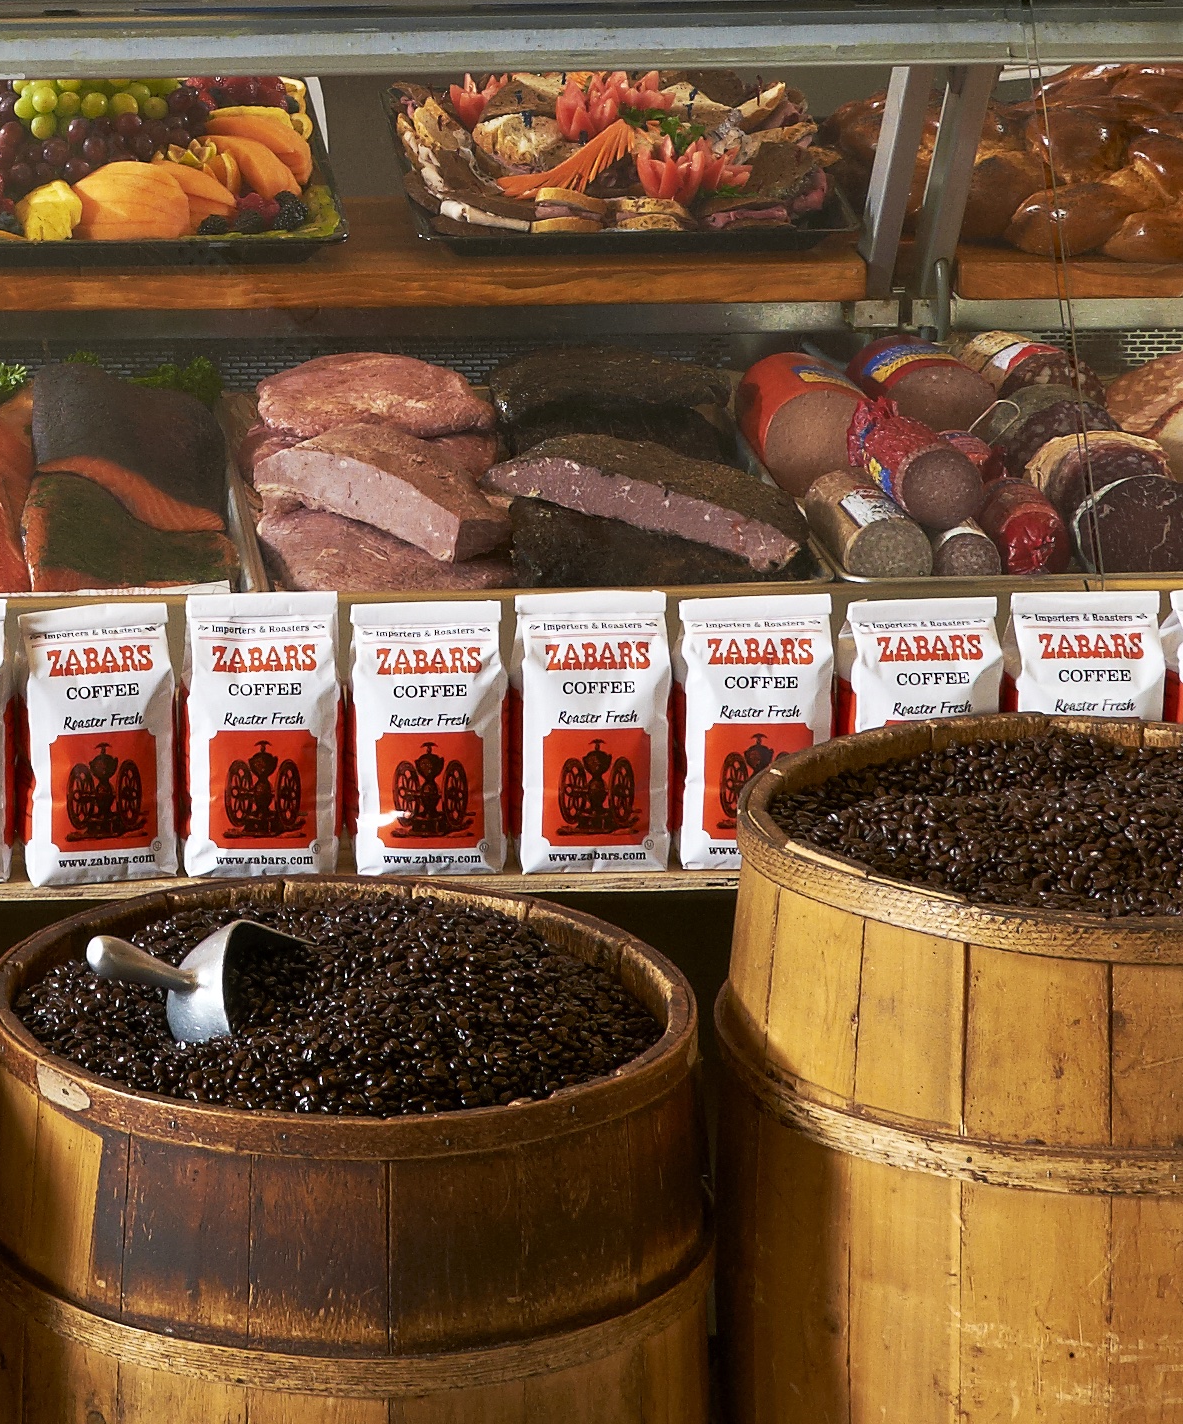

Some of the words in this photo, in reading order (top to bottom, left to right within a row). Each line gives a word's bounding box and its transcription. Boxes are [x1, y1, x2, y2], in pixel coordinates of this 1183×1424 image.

[897, 672, 969, 686] COFFEE
[1059, 670, 1131, 682] COFFEE
[229, 683, 301, 696] COFFEE
[562, 681, 635, 695] COFFEE
[893, 702, 936, 716] Roaster
[940, 701, 973, 714] Fresh
[223, 712, 267, 727] Roaster
[270, 712, 306, 726] Fresh
